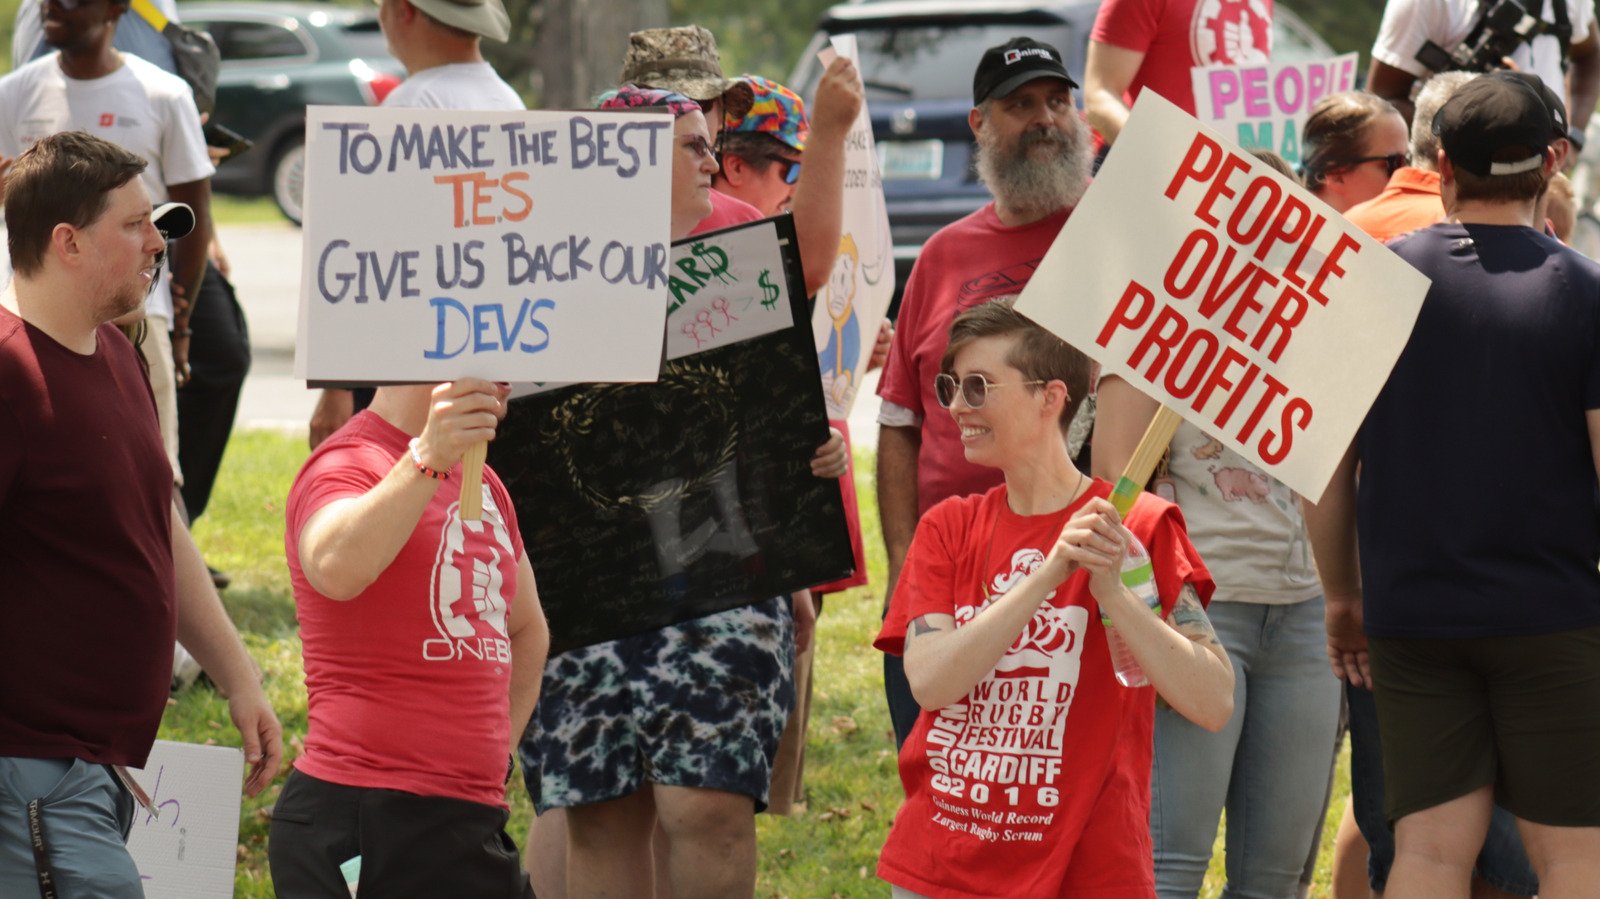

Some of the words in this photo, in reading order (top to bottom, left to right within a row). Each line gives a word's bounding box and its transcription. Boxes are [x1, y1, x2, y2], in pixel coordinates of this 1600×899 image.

[322, 122, 382, 174] TO
[388, 123, 494, 172] MAKE
[501, 122, 558, 166] THE
[569, 116, 671, 178] BEST
[1164, 131, 1361, 307] PEOPLE
[318, 239, 420, 304] GIVE
[436, 240, 485, 289] US
[501, 232, 593, 285] BACK
[600, 240, 669, 289] OUR
[1163, 229, 1309, 364] OVER
[424, 296, 555, 359] DEVS
[1095, 279, 1313, 465] PROFITS
[423, 637, 511, 663] ONEB
[974, 680, 1071, 703] WORLD
[971, 703, 1064, 726] RUGBY
[964, 726, 1059, 751] FESTIVAL
[950, 749, 1062, 785] CARDIFF
[949, 778, 1060, 807] 2016
[931, 795, 969, 816] Guinness
[971, 807, 1003, 824] World
[1006, 811, 1053, 825] Record
[932, 812, 967, 832] Largest
[970, 822, 999, 842] Rugby
[1002, 829, 1043, 842] Scrum
